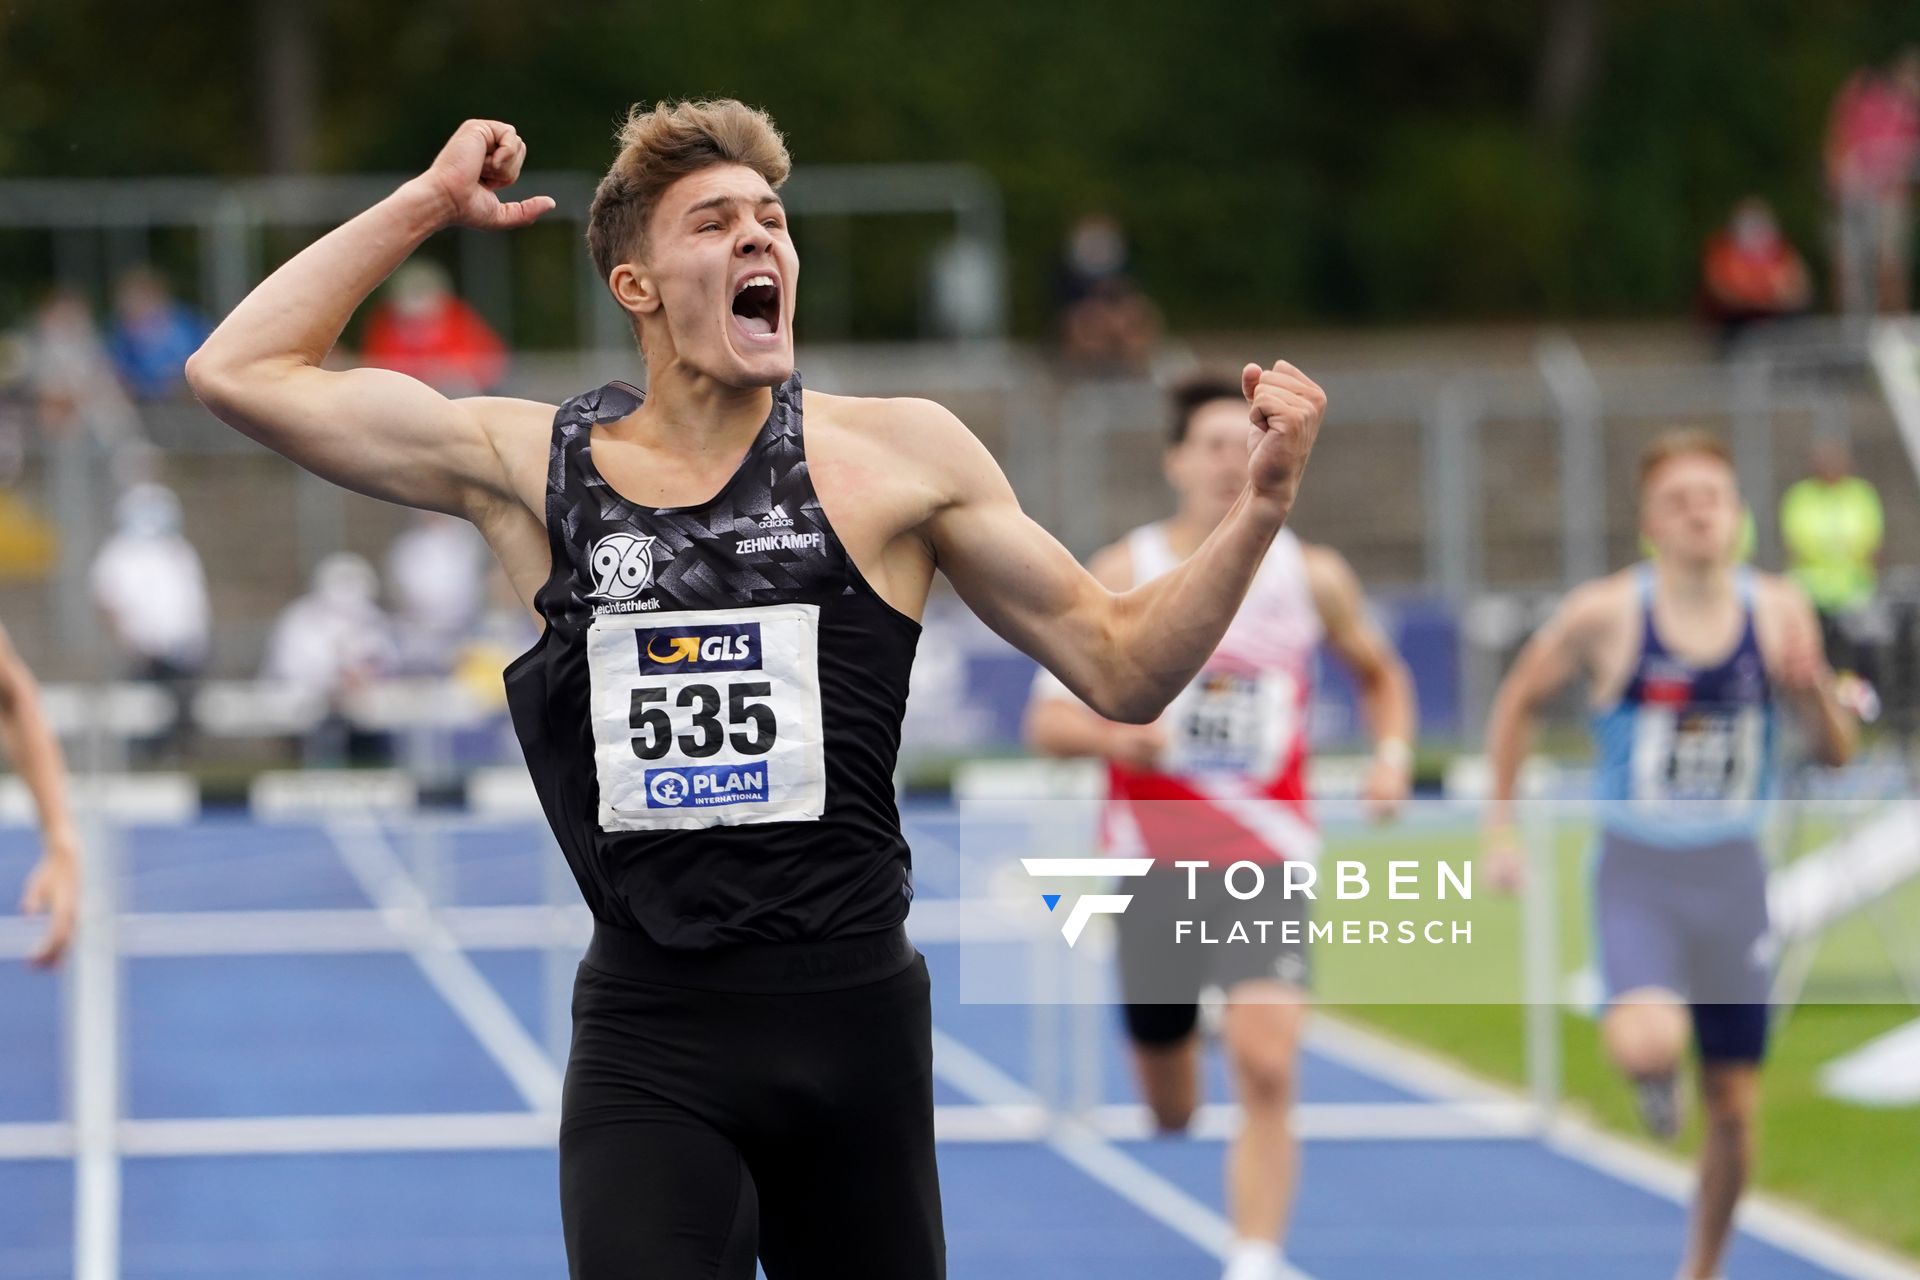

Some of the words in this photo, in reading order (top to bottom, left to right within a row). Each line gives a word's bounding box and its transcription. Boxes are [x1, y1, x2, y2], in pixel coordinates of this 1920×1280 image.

[759, 519, 794, 529] adidas
[735, 533, 820, 555] ZEHNKAMPF
[593, 540, 649, 595] 96
[592, 597, 661, 616] Leichtathletik
[701, 635, 750, 661] GLS
[629, 681, 777, 760] 535
[693, 771, 763, 794] PLAN
[695, 792, 763, 805] INTERNATIONAL
